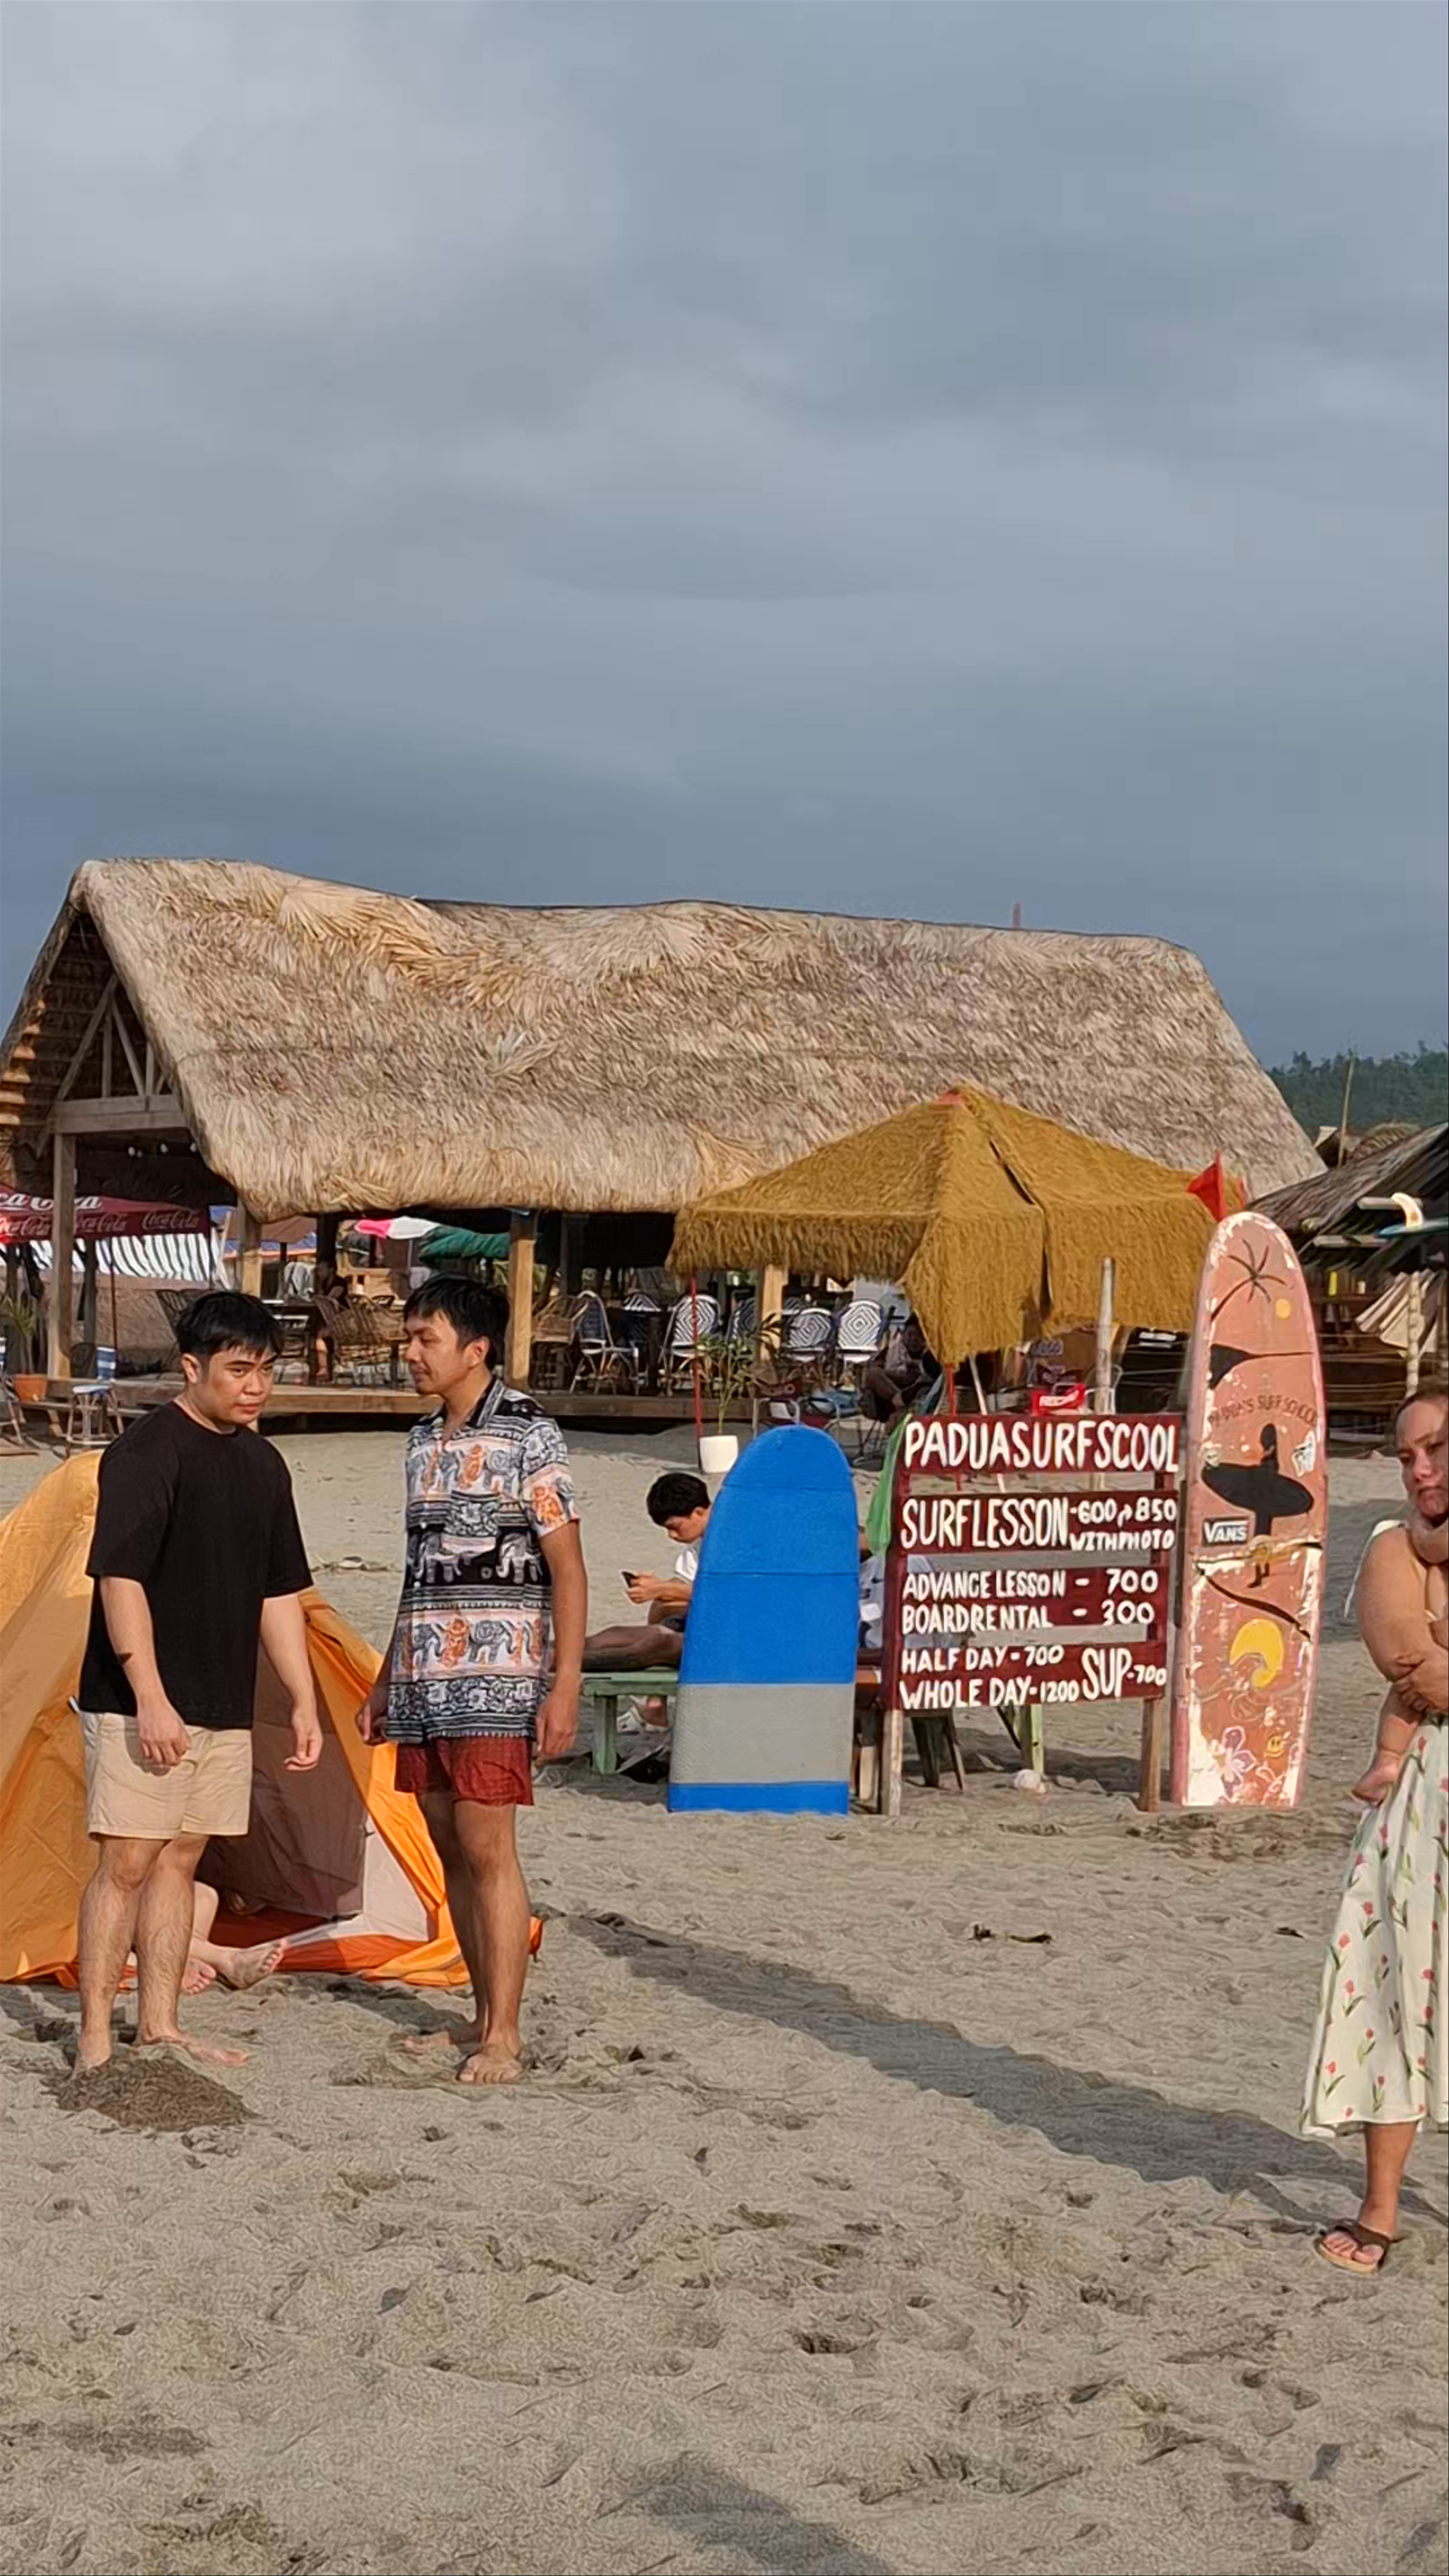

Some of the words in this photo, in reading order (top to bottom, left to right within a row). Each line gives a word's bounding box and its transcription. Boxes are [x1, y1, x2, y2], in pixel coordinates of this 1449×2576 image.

[1135, 1496, 1177, 1522] 850
[1204, 1520, 1248, 1544] VANS
[902, 1570, 992, 1601] ADVANCE
[995, 1569, 1066, 1598] LESSON
[1106, 1568, 1158, 1596] 700
[1101, 1599, 1155, 1626] 300
[901, 1647, 961, 1674] HALF
[899, 1679, 983, 1710] WHOLE
